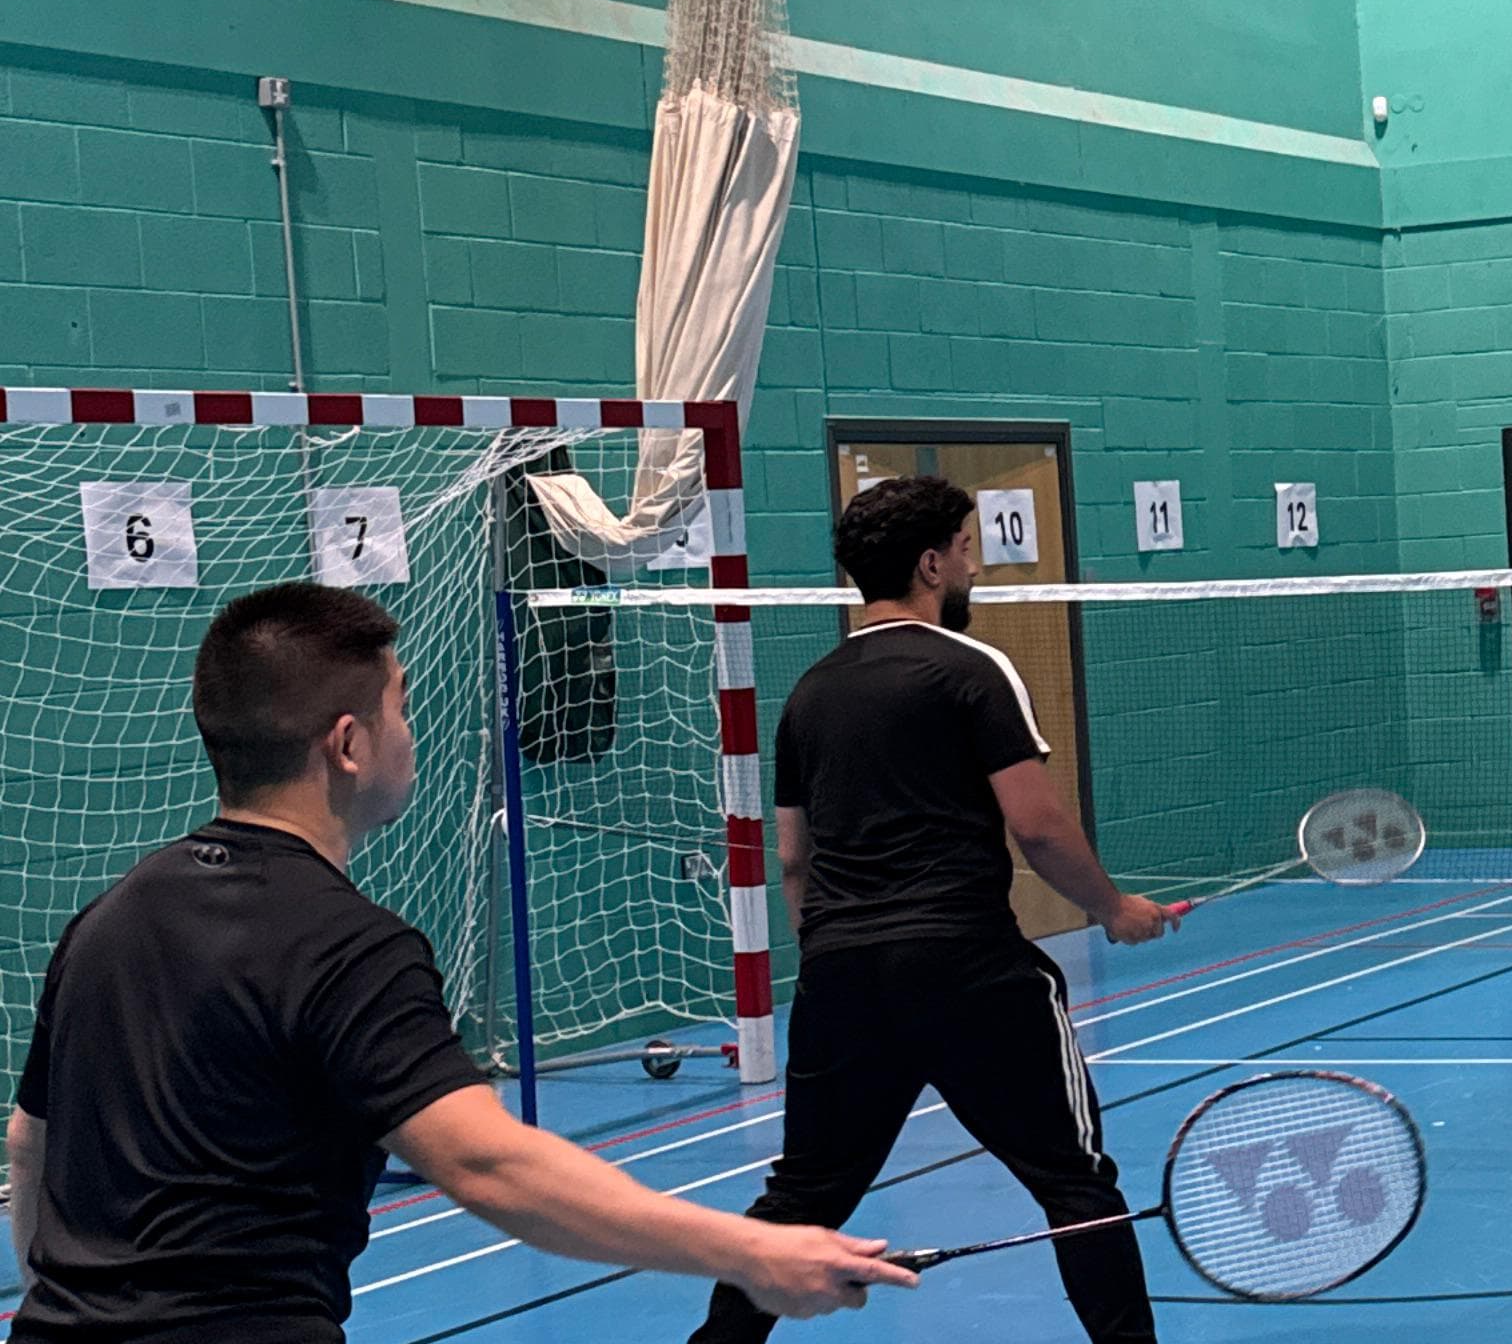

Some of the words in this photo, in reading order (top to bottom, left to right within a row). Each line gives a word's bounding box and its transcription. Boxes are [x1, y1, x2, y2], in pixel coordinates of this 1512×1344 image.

[995, 511, 1023, 546] 10
[1150, 501, 1169, 534] 11
[1287, 501, 1308, 532] 12
[126, 513, 154, 563] 6
[345, 516, 367, 560] 7
